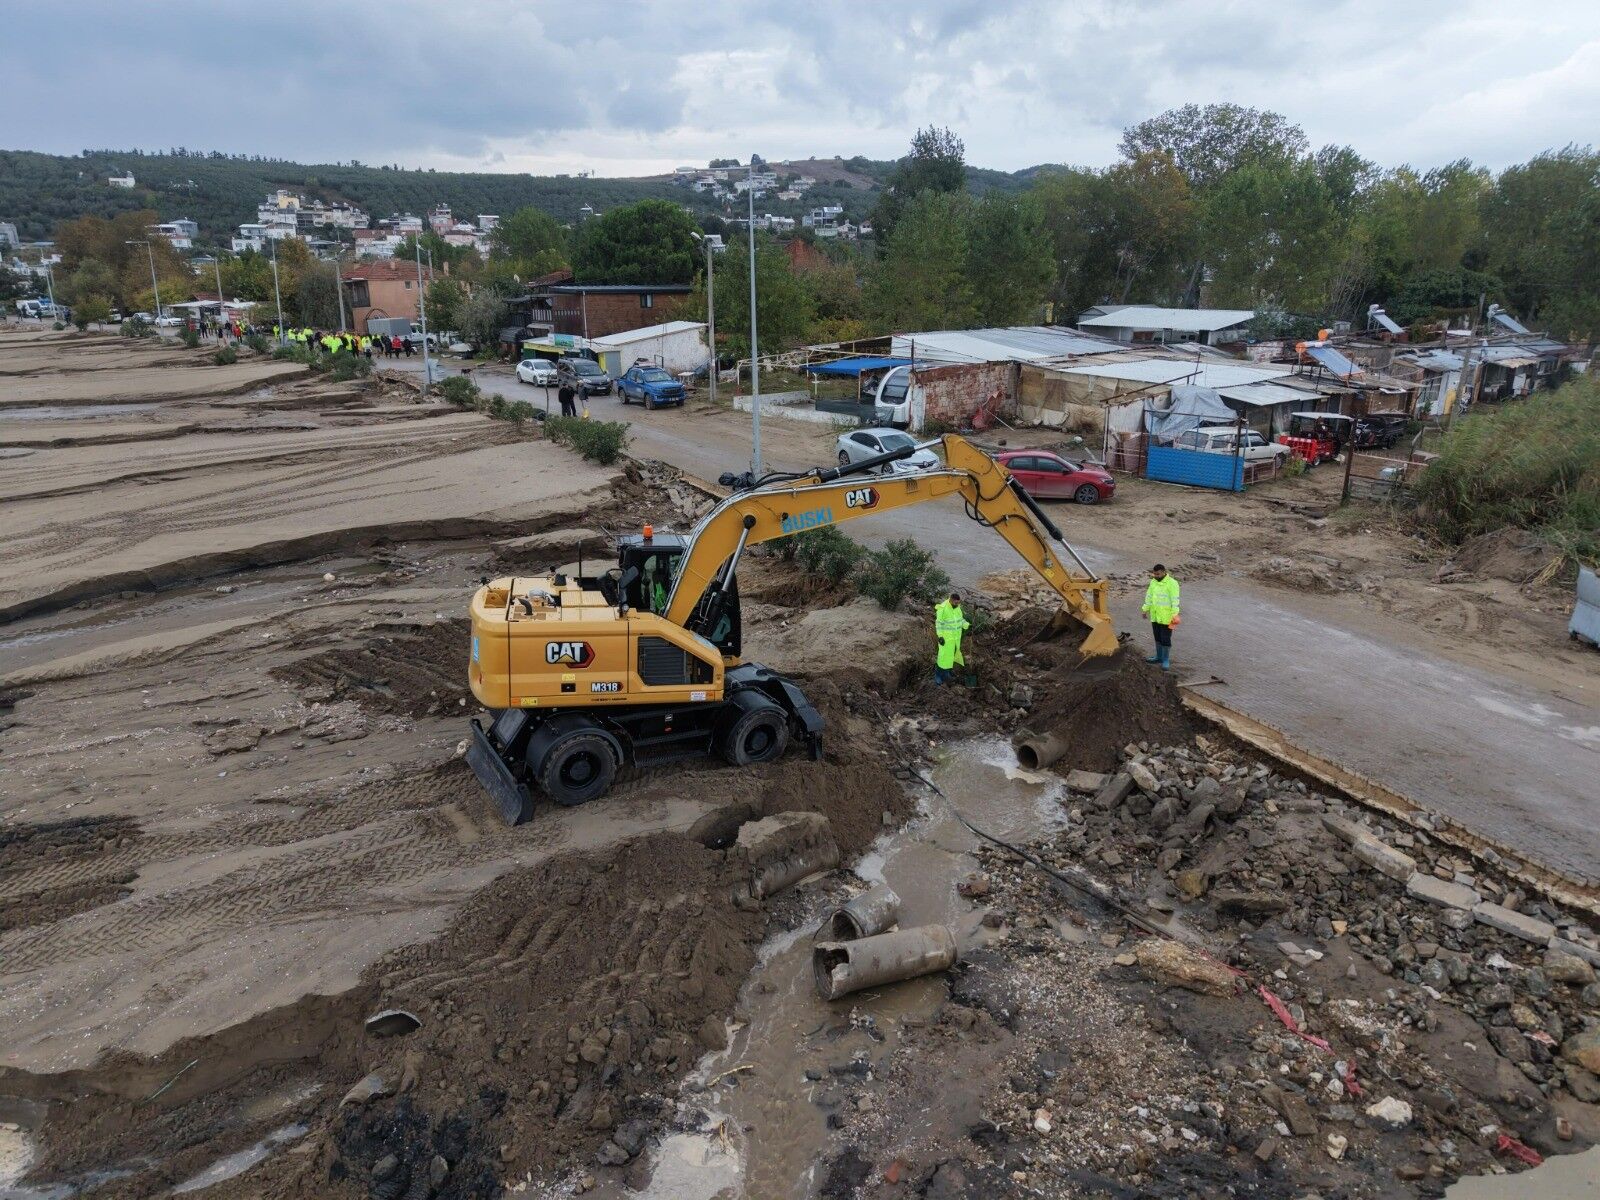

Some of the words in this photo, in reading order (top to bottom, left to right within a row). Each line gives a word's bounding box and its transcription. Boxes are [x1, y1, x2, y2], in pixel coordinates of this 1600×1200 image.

[846, 488, 871, 508] CAT
[546, 642, 584, 663] CAT
[591, 682, 618, 692] M318
